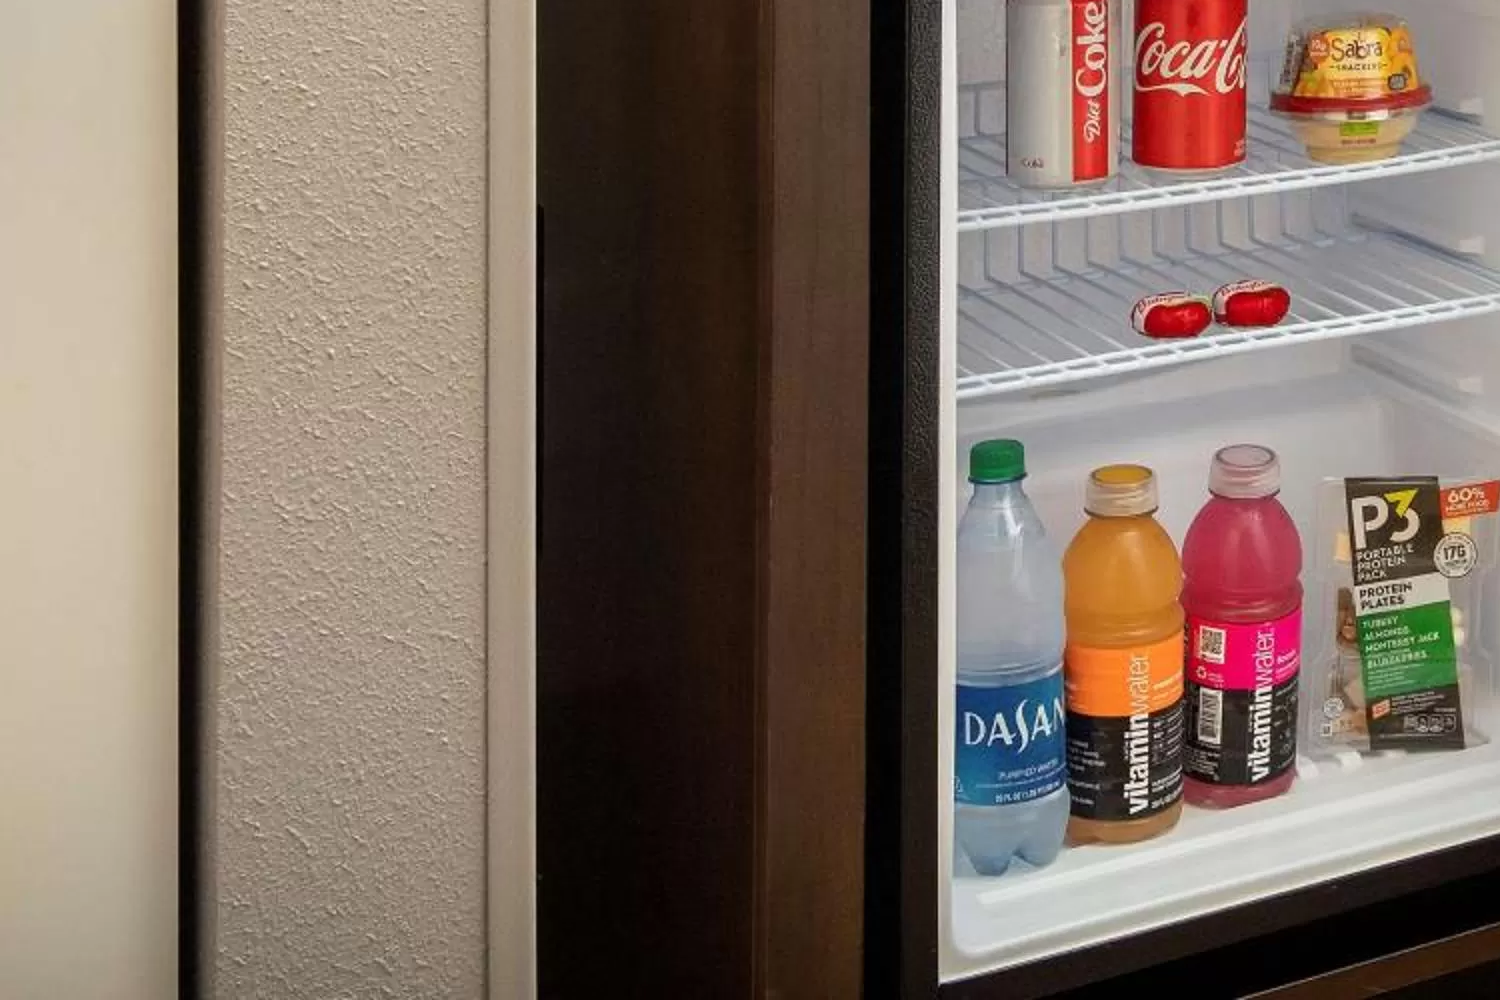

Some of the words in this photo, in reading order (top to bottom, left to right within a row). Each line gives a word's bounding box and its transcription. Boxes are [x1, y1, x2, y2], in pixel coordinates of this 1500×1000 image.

[1331, 37, 1383, 62] Sabra
[1447, 487, 1486, 503] 60%
[1351, 487, 1420, 550] P3
[1357, 543, 1415, 561] PORTABLE
[1358, 556, 1407, 571] PROTEIN
[1358, 569, 1388, 582] PACK
[1360, 581, 1413, 598] PROTEIN
[1361, 594, 1406, 611] PLATES
[1247, 629, 1275, 783] vitaminwater
[964, 697, 1066, 754] DASAN
[1123, 654, 1151, 815] vitaminwater
